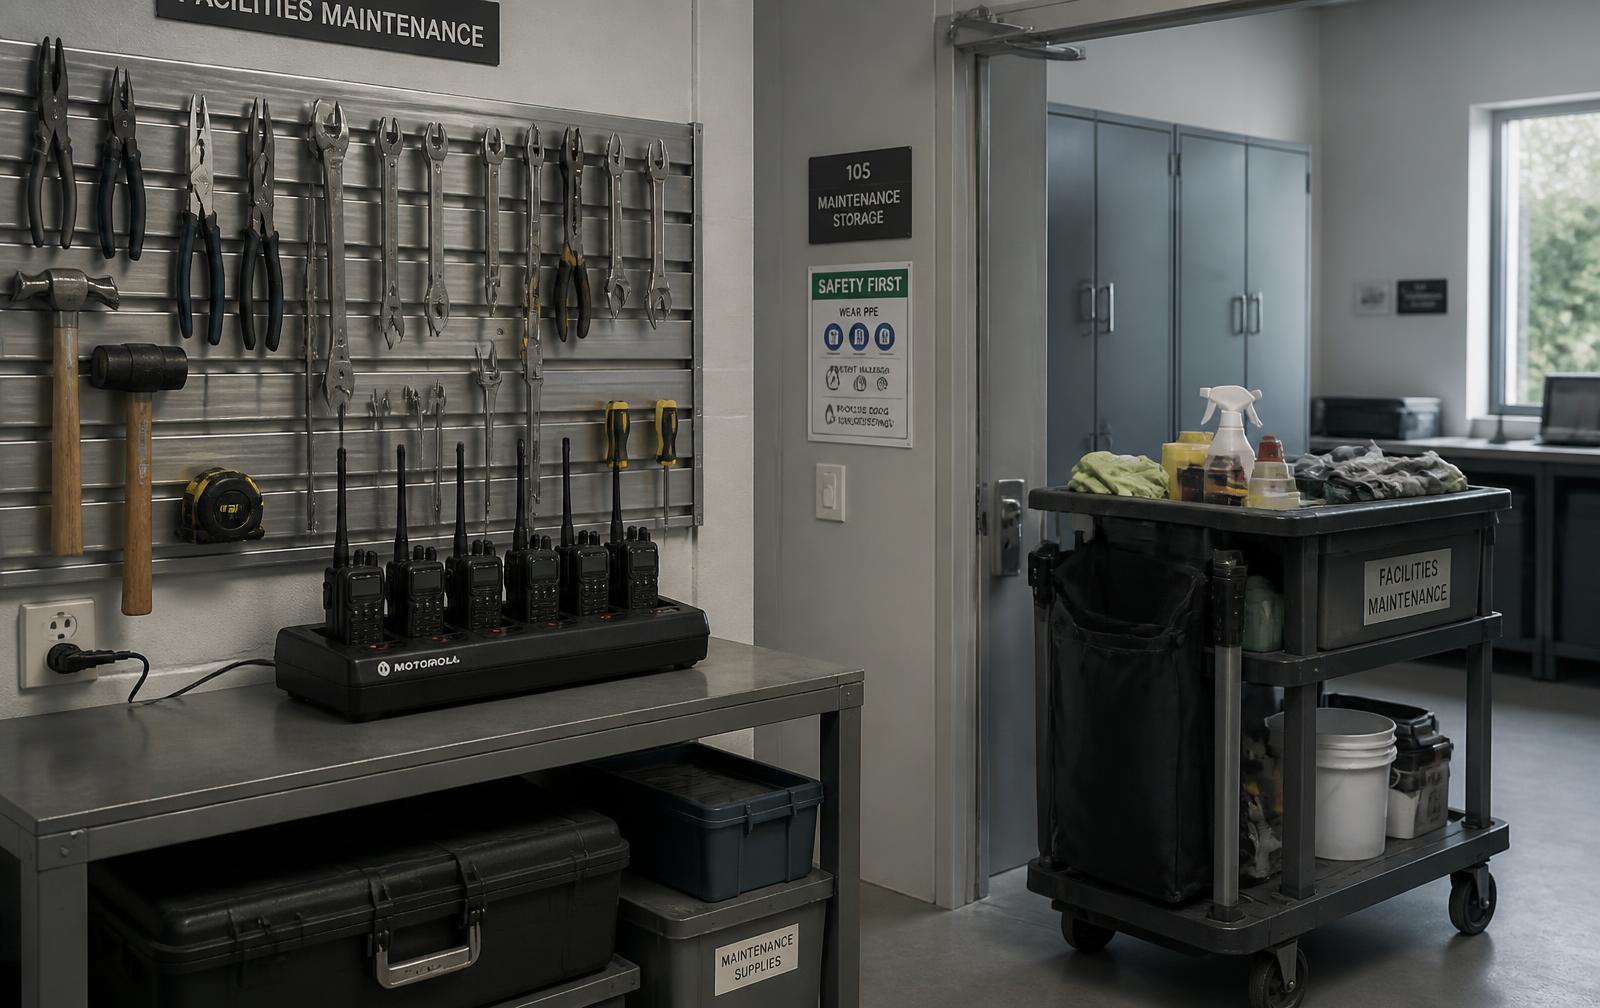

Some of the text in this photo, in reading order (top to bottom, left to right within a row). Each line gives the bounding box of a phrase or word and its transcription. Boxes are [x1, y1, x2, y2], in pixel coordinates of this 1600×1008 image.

[178, 0, 485, 48] ILITIES MAINTENANCE
[846, 162, 871, 181] 105
[818, 189, 901, 210] MAINTENANCE
[833, 210, 884, 227] STORAGE
[818, 276, 902, 294] SAFETY FIRST
[839, 306, 879, 317] WEAR PPE
[1379, 559, 1438, 587] FACILITIES
[1368, 583, 1447, 615] MAINTENANCE
[721, 933, 794, 967] MAINTENANCE
[734, 955, 782, 981] SUPPLIES
